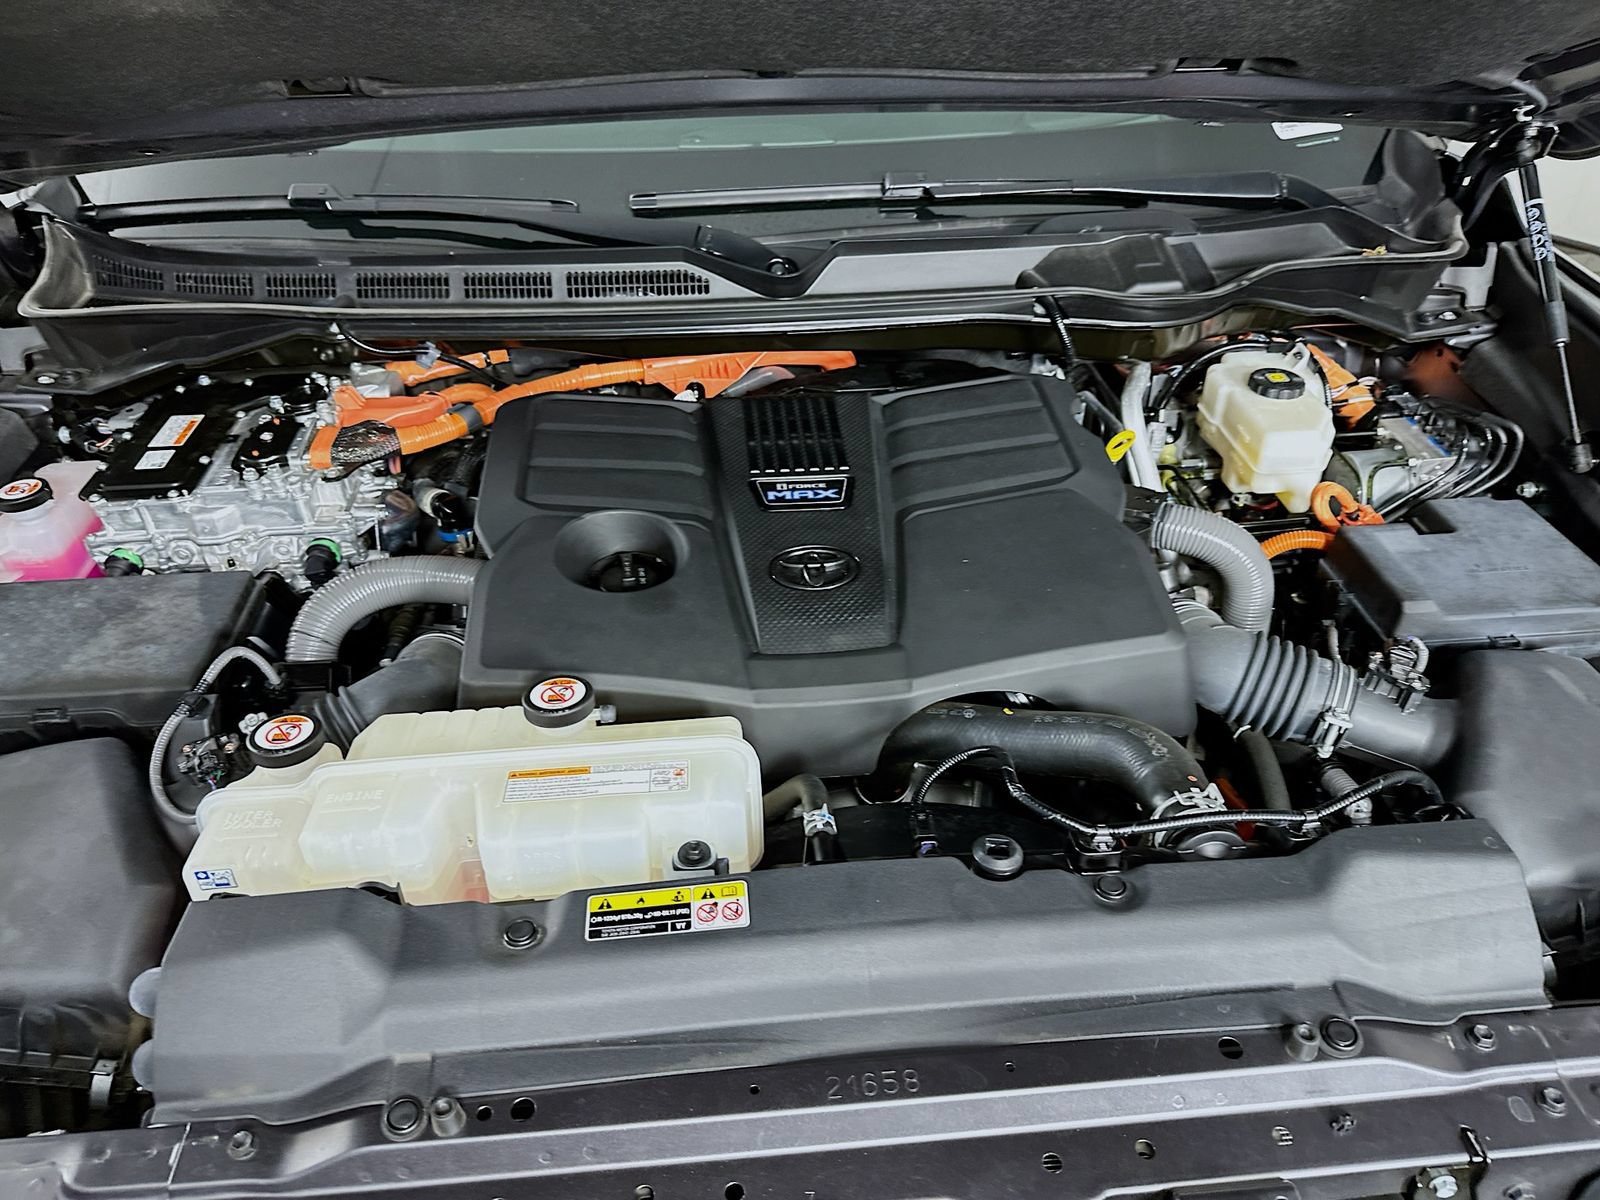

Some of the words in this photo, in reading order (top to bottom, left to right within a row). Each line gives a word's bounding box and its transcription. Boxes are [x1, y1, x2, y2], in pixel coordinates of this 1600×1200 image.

[767, 489, 841, 500] MAX
[327, 790, 385, 803] ENGINE
[825, 1068, 921, 1100] 21658
